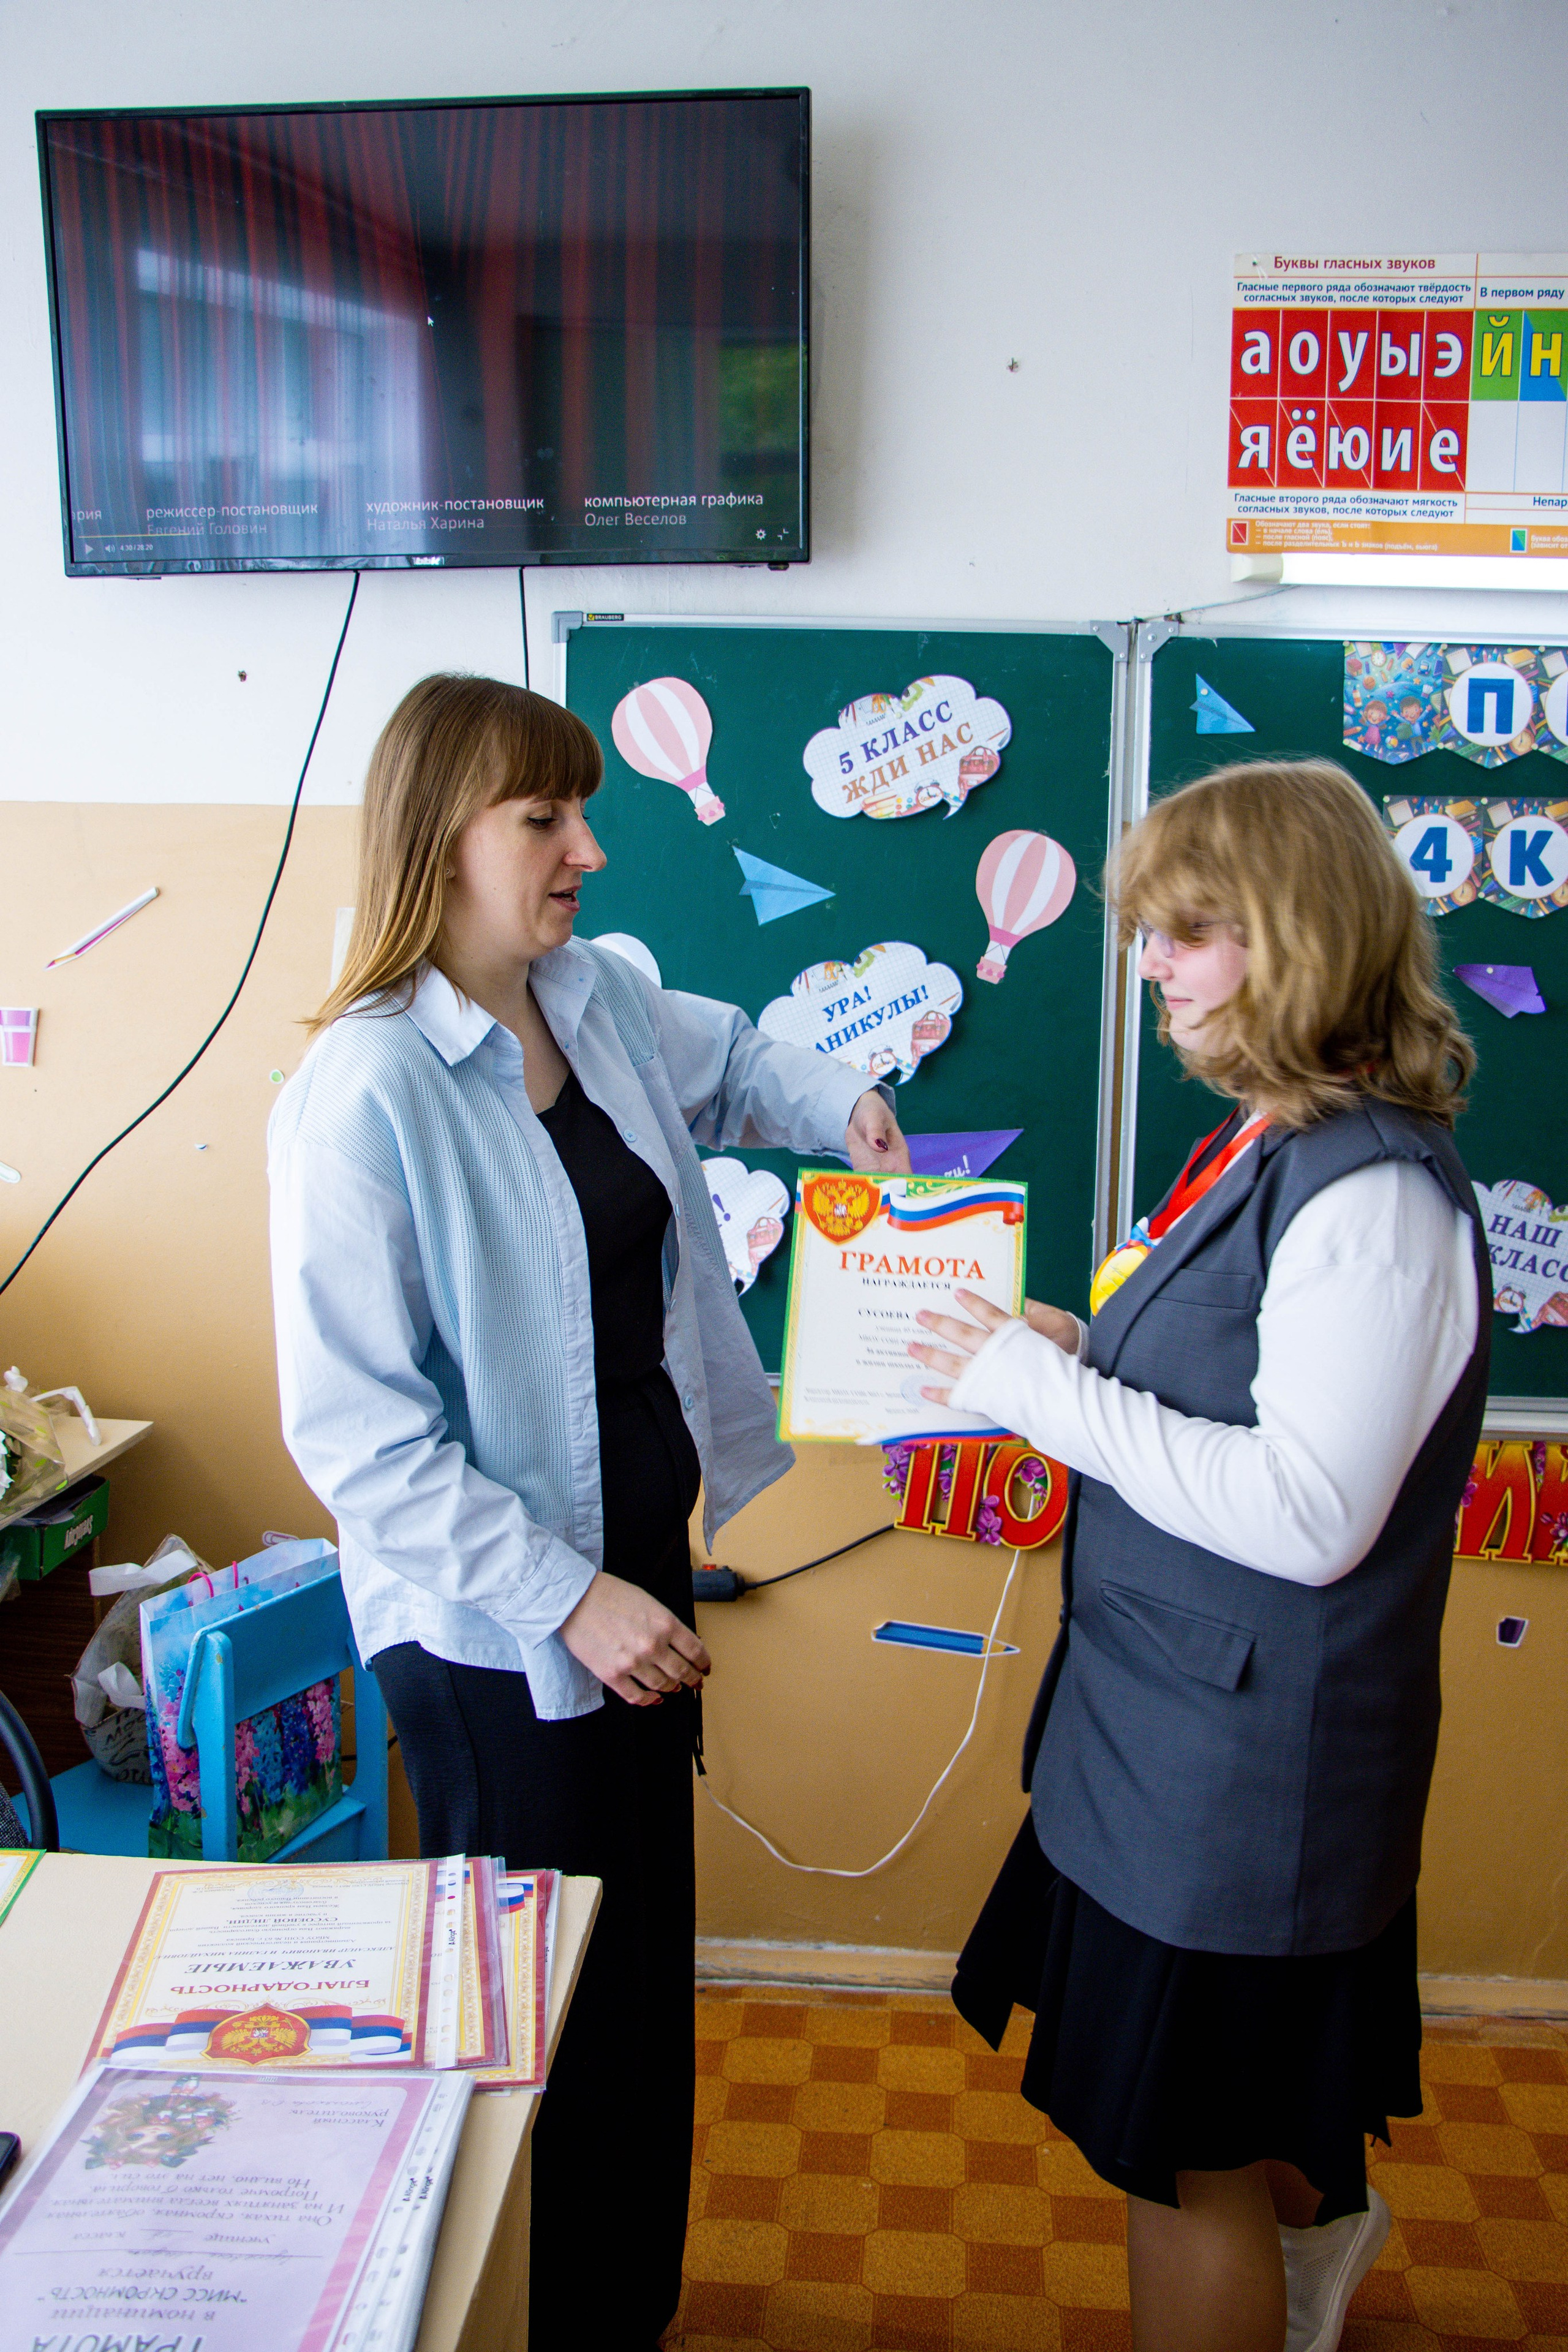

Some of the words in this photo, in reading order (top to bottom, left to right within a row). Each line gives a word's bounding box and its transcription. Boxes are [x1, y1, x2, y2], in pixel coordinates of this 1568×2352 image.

[1274, 256, 1318, 270] Буквы
[1324, 259, 1382, 269] гласных
[1387, 259, 1435, 271] звуков
[1237, 282, 1279, 292] Гласные
[1282, 284, 1323, 294] первого
[1326, 284, 1351, 294] ряда
[1354, 284, 1416, 293] обозначают
[1418, 283, 1471, 294] твёрдость
[1480, 287, 1487, 297] В
[1492, 288, 1534, 300] первом
[1537, 289, 1566, 301] ряду
[1244, 295, 1297, 303] согласных
[1300, 295, 1336, 304] звуков,
[1373, 295, 1415, 305] которых
[1419, 295, 1463, 305] следуют
[366, 497, 545, 514] художник-постановщик
[584, 496, 696, 510] компьютерная
[702, 493, 764, 509] графика
[1234, 492, 1276, 503] Гласные
[1278, 495, 1319, 505] второго
[1322, 496, 1347, 506] ряда
[1350, 496, 1409, 507] обозначают
[1412, 498, 1458, 507] мягкость
[146, 503, 318, 521] режиссер-постановщик
[584, 513, 618, 528] Олег
[625, 511, 687, 526] Веселов
[1237, 505, 1290, 514] согласных
[1293, 506, 1329, 516] звуков,
[1332, 507, 1363, 515] после
[1365, 507, 1408, 518] которых
[1411, 509, 1453, 519] следуют
[147, 522, 205, 536] Евгений
[208, 522, 268, 535] Головин
[366, 516, 426, 532] Наталья
[430, 516, 484, 530] Харина
[839, 751, 853, 774] 5
[860, 700, 953, 764] КЛАСС
[842, 754, 910, 804] ЖДИ
[916, 722, 974, 767] НАС
[822, 986, 872, 1023] УРА!
[815, 984, 929, 1054] АНИКУЛЫ!
[1487, 1213, 1563, 1248] НАШ
[839, 1250, 986, 1280] ГРАМОТА
[184, 1959, 356, 1974] УВАЖАЕМЫЕ
[170, 1979, 370, 1995] БЛАГОДАРНОСТЬ
[289, 2109, 390, 2118] руководитель
[312, 2118, 385, 2128] Классный
[160, 2185, 178, 2195] б
[183, 2185, 235, 2195] только
[240, 2186, 318, 2201] Погромче
[170, 2197, 221, 2207] всегда
[225, 2200, 300, 2210] занятиях
[326, 2204, 345, 2214] И
[73, 2231, 126, 2241] класса
[204, 2233, 277, 2244] ученице
[98, 2264, 213, 2281] вручается
[51, 2305, 196, 2321] номинации
[205, 2310, 216, 2321] в
